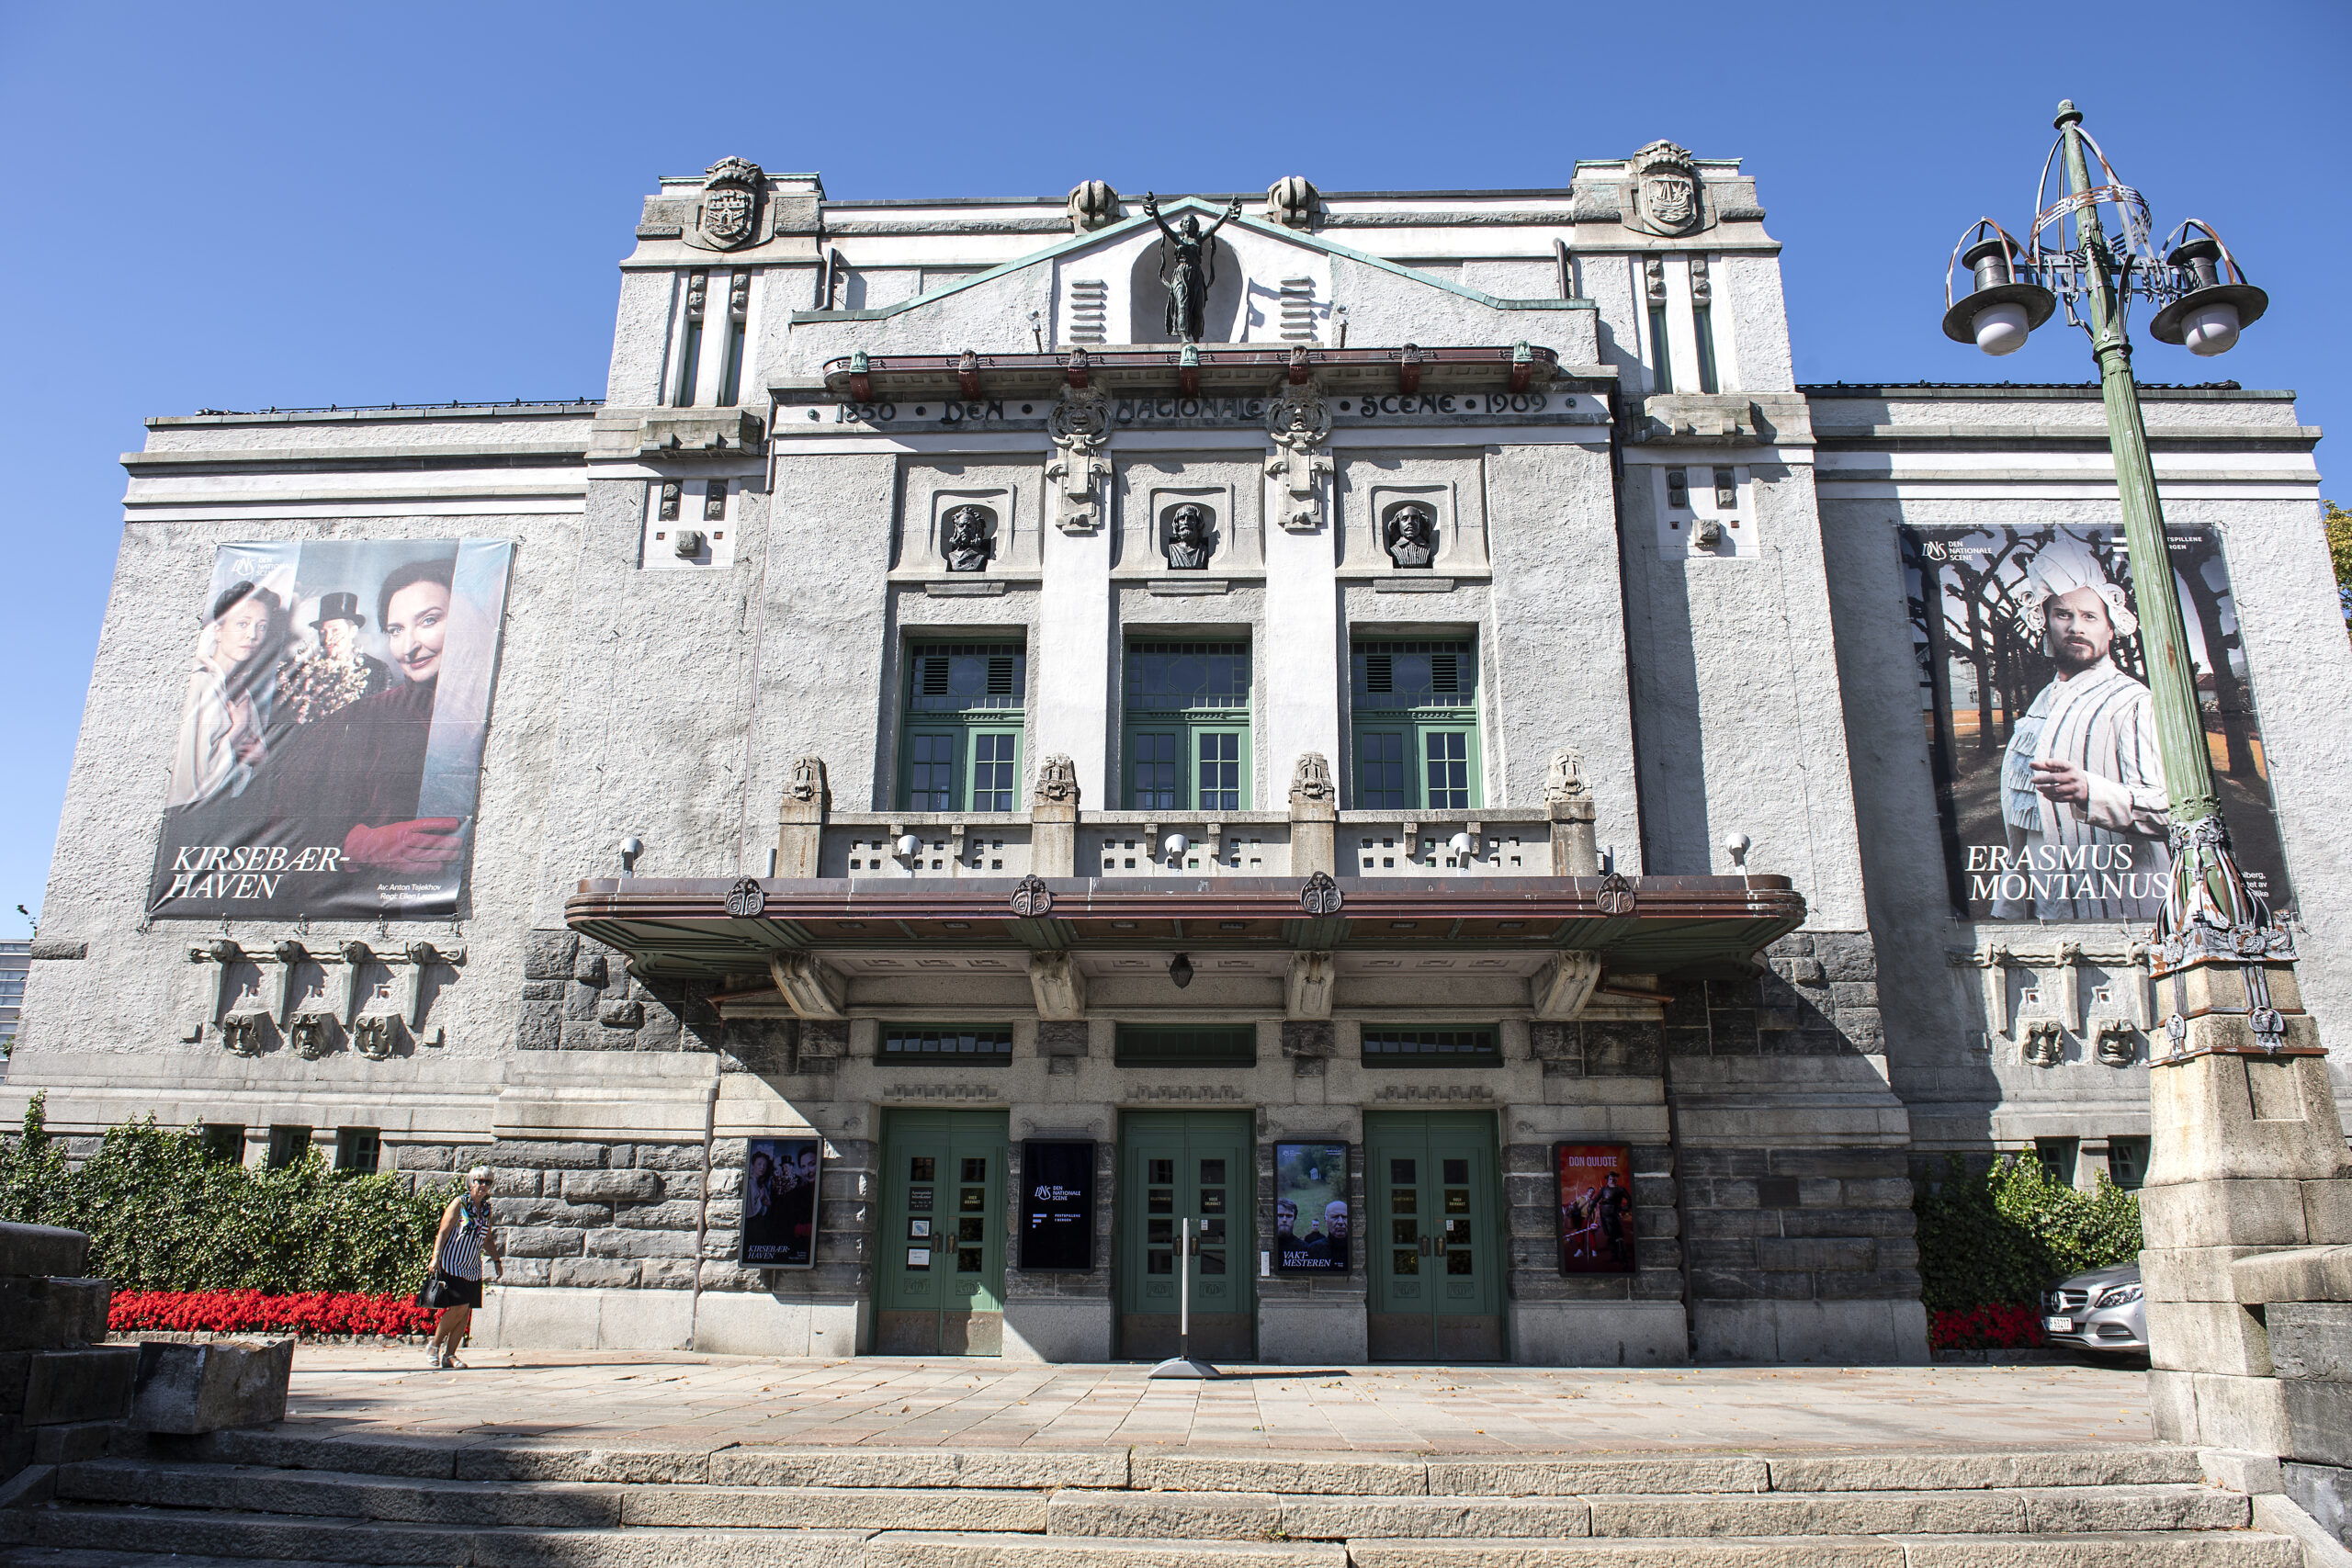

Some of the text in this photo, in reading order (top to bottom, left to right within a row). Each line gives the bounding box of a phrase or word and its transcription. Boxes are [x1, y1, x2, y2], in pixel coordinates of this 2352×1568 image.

[835, 391, 1548, 424] 1850 DEN NATIONALE SCENE 1909
[1921, 540, 1948, 561] DNS
[169, 845, 351, 873] KIRSEBÆR-
[1964, 843, 2133, 872] ERASMUS
[166, 874, 285, 900] HAVEN
[390, 883, 411, 891] Anton
[412, 883, 442, 893] Tsjekhov
[1969, 872, 2170, 901] MONTANUS
[1568, 1156, 1618, 1168] DON QUIJOTE
[1283, 1258, 1331, 1267] MESTEREN
